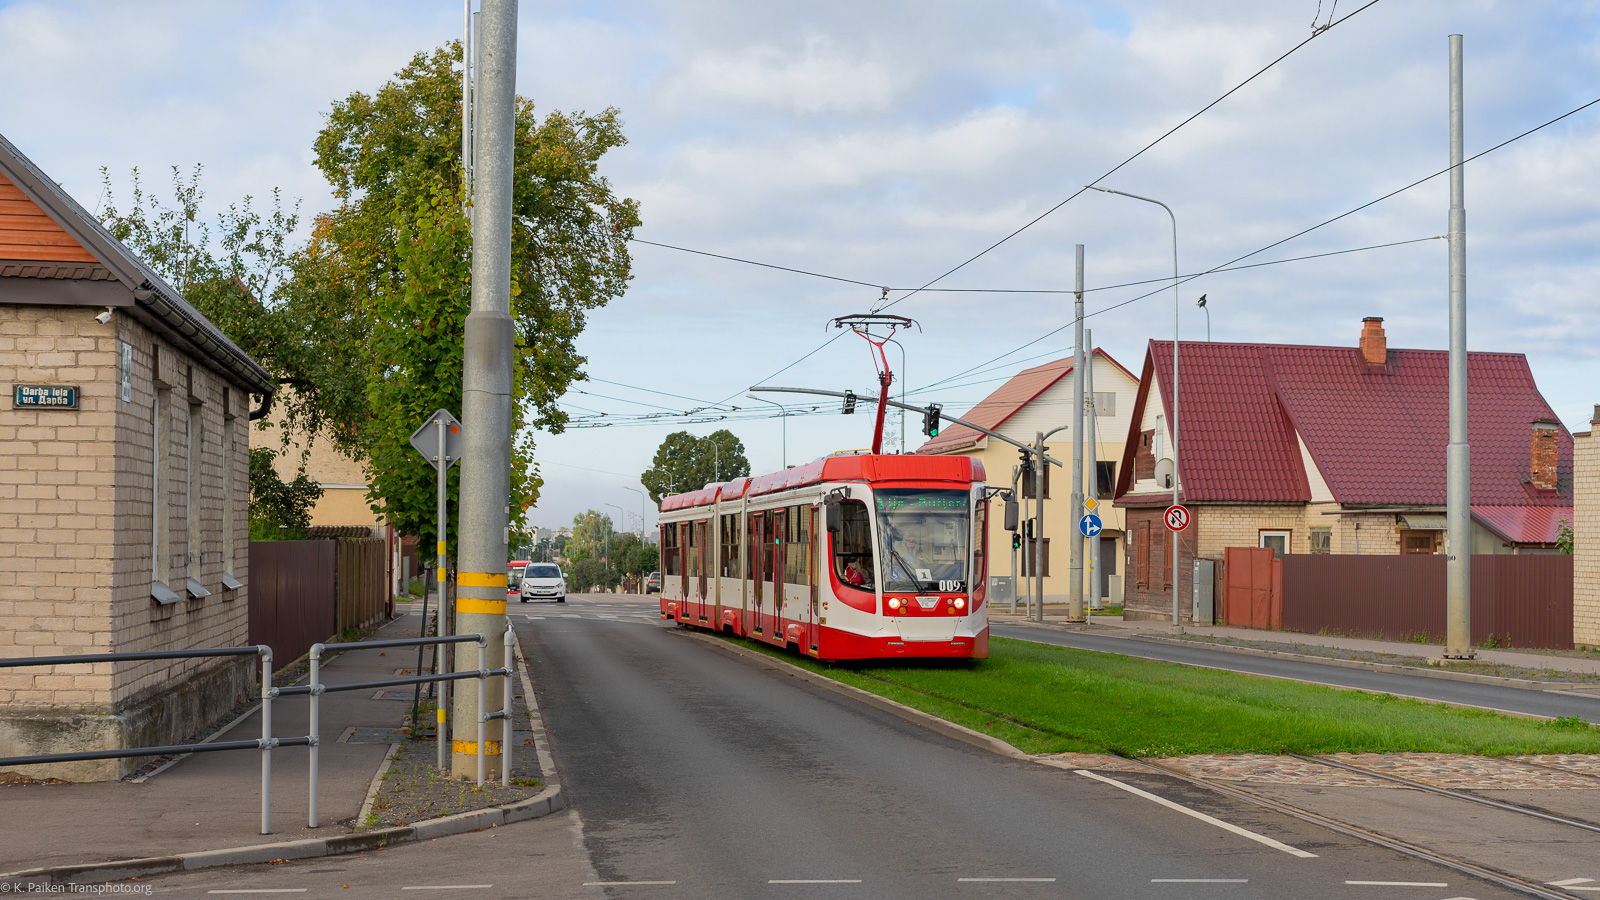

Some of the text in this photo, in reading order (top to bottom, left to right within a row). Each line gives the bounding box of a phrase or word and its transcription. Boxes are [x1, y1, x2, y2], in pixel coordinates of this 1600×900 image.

[22, 387, 49, 396] Darba
[22, 395, 68, 406] ул. Дарба
[921, 571, 929, 579] 1
[938, 579, 961, 592] 009
